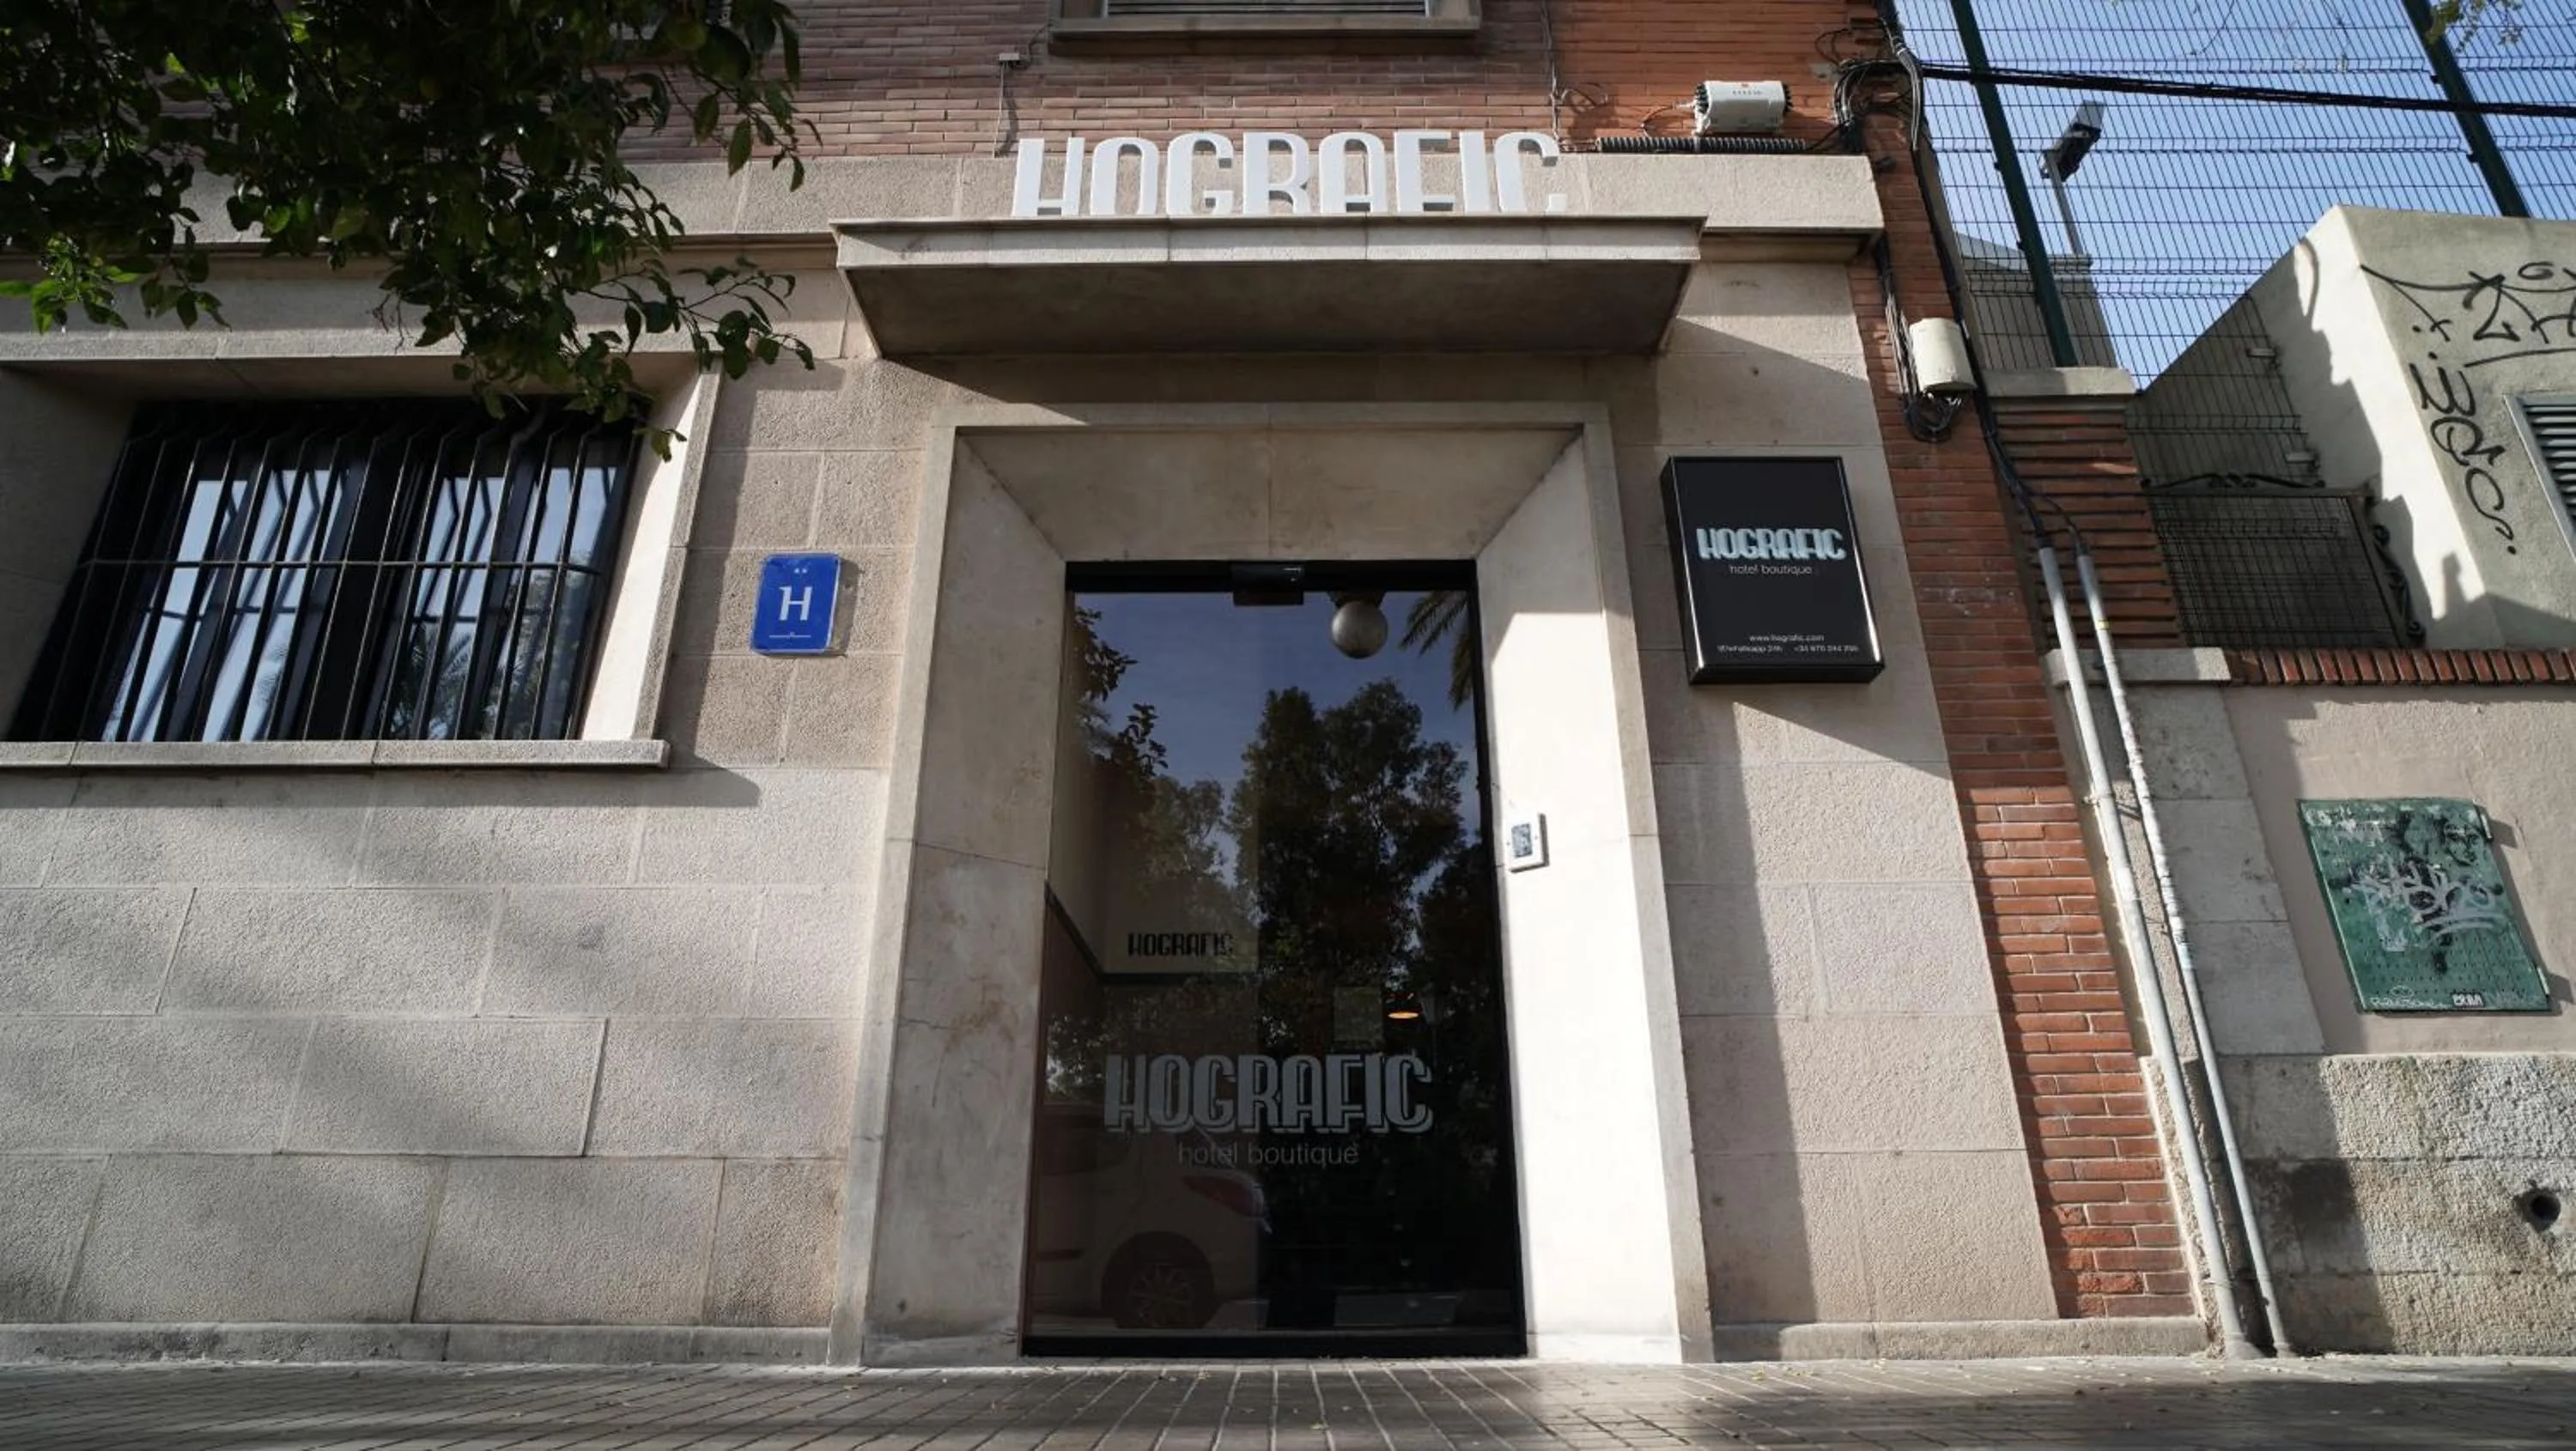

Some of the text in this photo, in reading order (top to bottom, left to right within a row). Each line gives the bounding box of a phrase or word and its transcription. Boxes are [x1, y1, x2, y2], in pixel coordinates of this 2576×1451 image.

[1012, 131, 1567, 217] HOGRAFIC
[1695, 527, 1847, 561] HOGRAFIC
[1729, 563, 1813, 576] hotel boutique
[779, 586, 813, 621] H
[1127, 932, 1234, 956] HOGRAFIC
[1103, 1053, 1434, 1135] HOGRAFIC
[1178, 1140, 1359, 1167] hotel boutique
